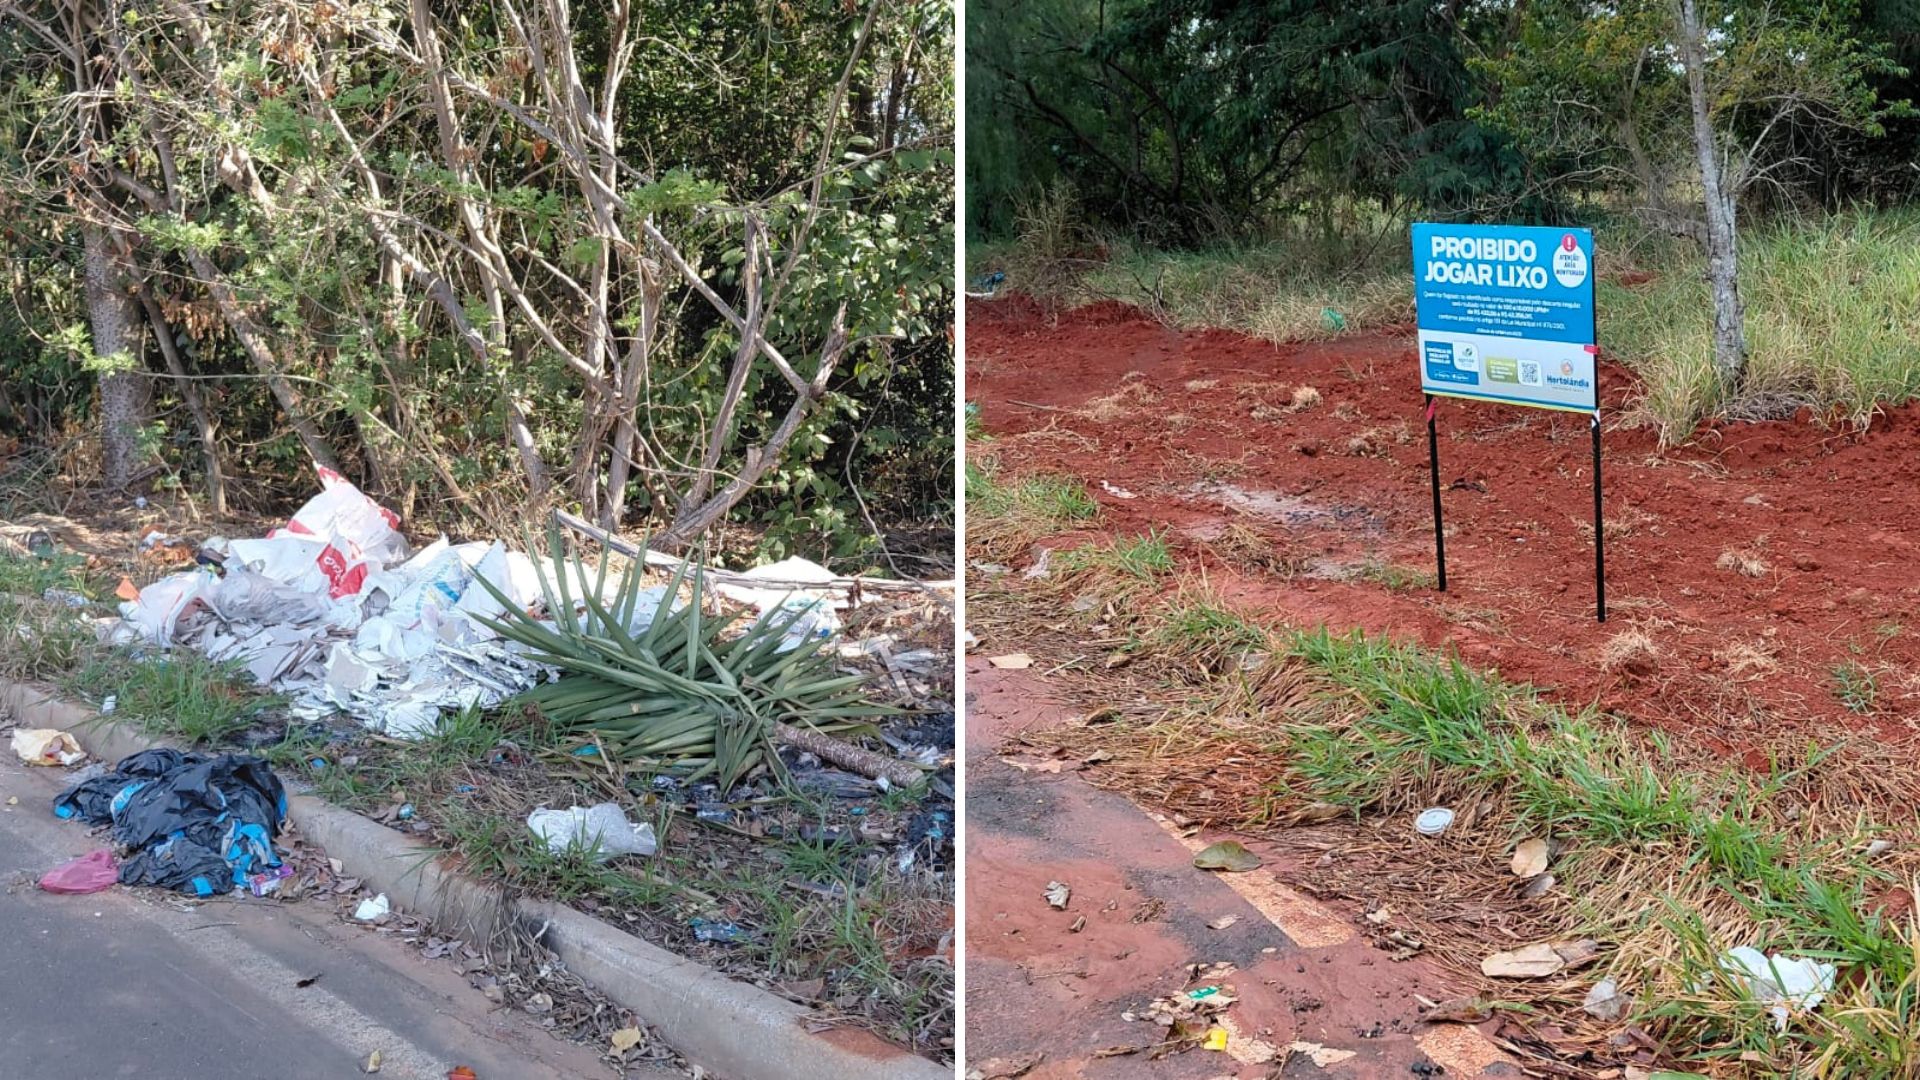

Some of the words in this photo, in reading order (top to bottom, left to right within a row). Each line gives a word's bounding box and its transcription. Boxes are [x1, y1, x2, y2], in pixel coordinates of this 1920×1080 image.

[1431, 235, 1537, 263] PROIBIDO
[1424, 261, 1493, 286] JOGAR
[1497, 264, 1548, 290] LIXO
[1546, 374, 1590, 388] Hortolândia
